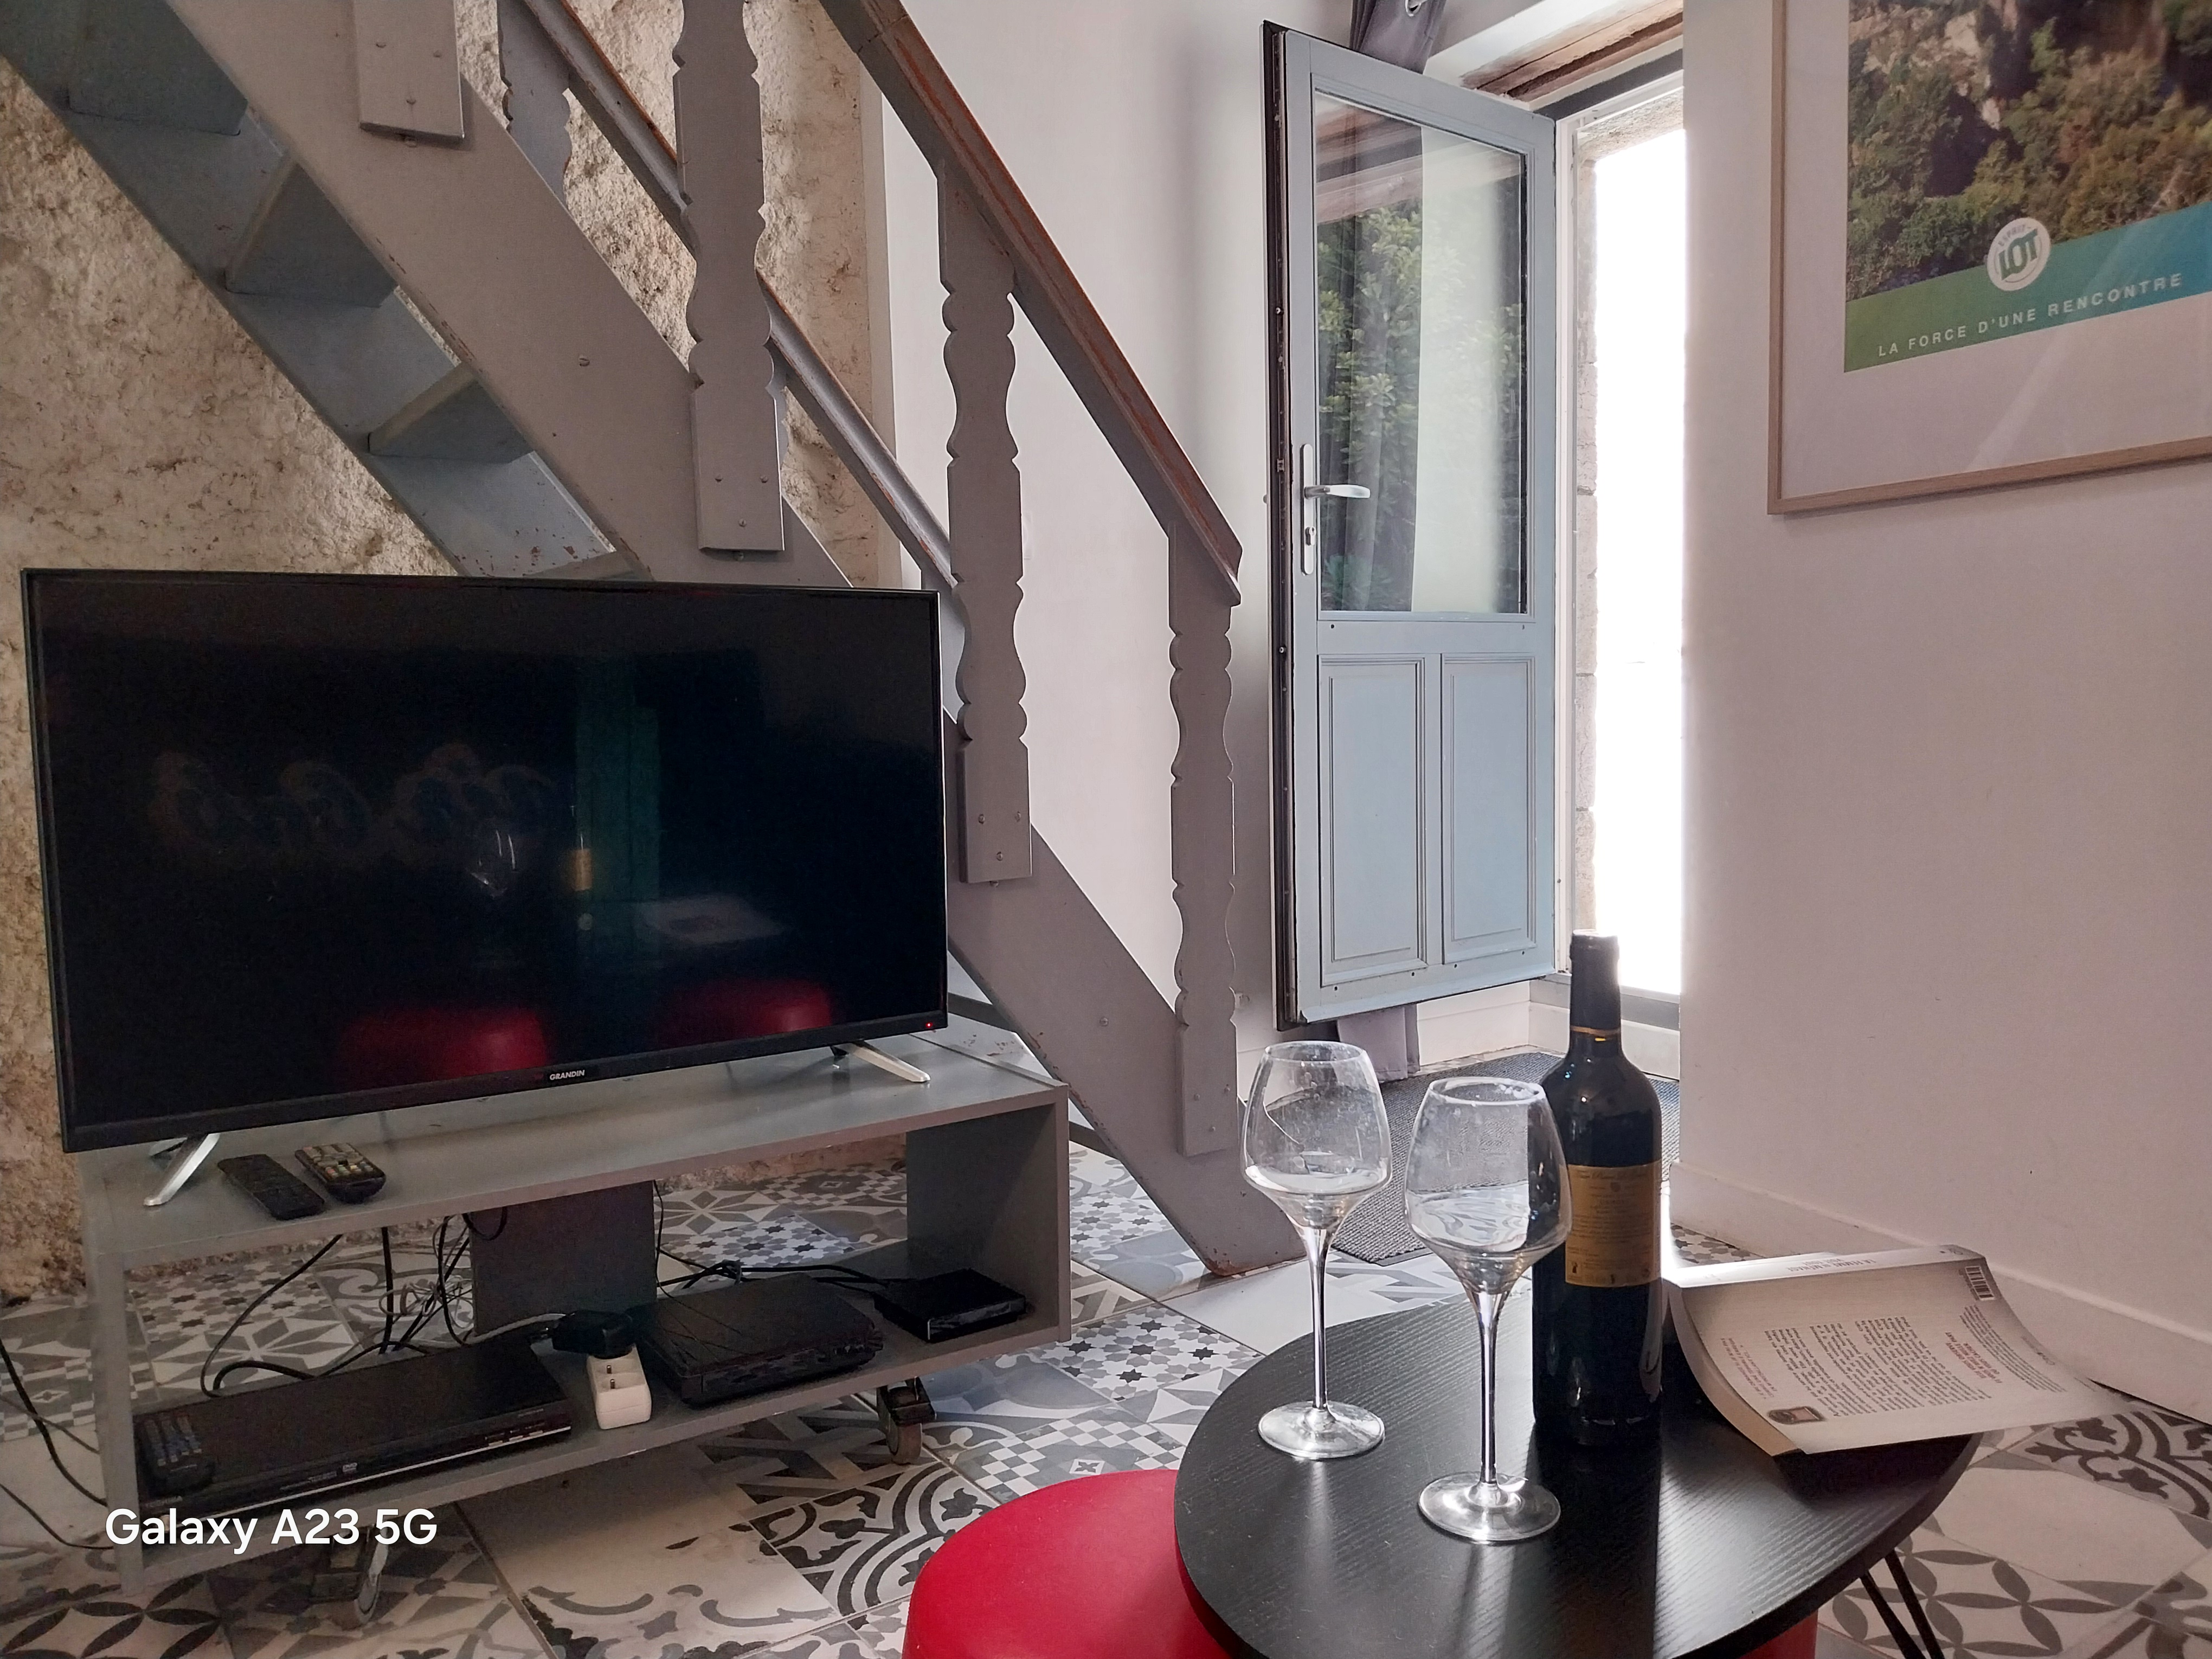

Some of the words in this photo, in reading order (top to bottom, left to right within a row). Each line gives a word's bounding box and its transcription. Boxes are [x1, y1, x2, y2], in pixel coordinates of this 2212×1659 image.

[1998, 228, 2039, 281] LOT
[1879, 342, 1898, 357] LA
[1908, 325, 1967, 350] FORCE
[1978, 308, 2036, 334] D'UNE
[2048, 273, 2184, 317] RENCONTRE
[549, 1069, 586, 1081] GRANDIN
